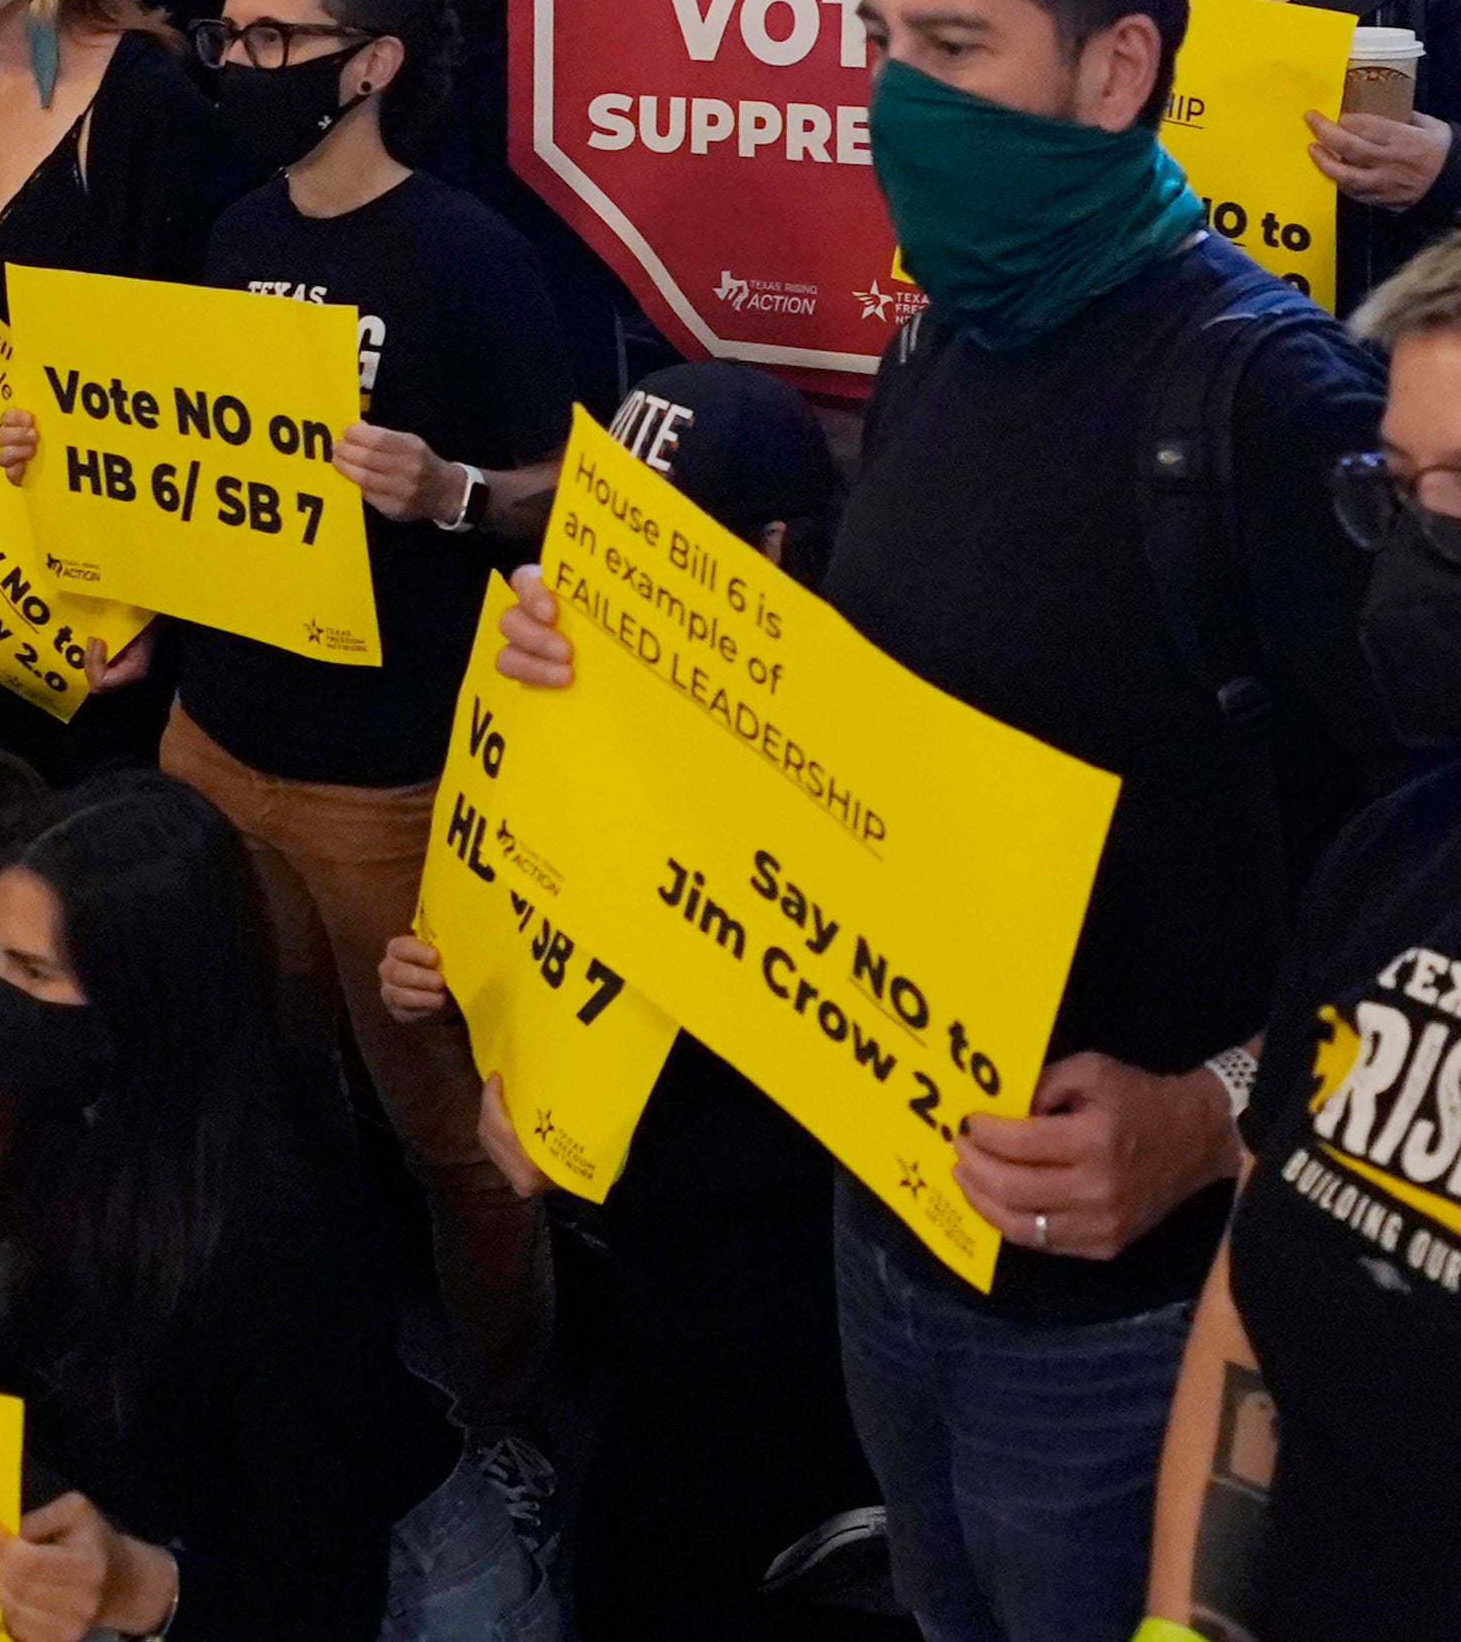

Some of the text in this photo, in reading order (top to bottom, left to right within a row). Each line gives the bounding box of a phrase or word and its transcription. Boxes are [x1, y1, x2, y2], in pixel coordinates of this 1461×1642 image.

[587, 92, 873, 165] SUPPRE
[1261, 213, 1311, 251] to
[747, 294, 816, 315] ACTION
[749, 280, 817, 294] TEXAS RISING
[896, 292, 930, 304] TEXA
[44, 366, 159, 429] Vote
[174, 387, 251, 446] NO
[269, 414, 333, 463] on
[67, 446, 324, 546] HB 6/ SB 7
[576, 453, 782, 640] House Bill 6 is
[0, 567, 51, 627] NO
[53, 625, 86, 670] to
[564, 511, 783, 695] an example of
[14, 642, 68, 693] 2.0
[556, 561, 886, 842] FAILED LEADERSHIP
[514, 854, 561, 898] ACTION
[576, 957, 625, 1027] 7
[658, 857, 745, 962] Jim
[762, 946, 897, 1084] Crow
[908, 1070, 970, 1142] 2.
[751, 849, 1000, 1097] Say NO to
[1281, 1149, 1402, 1253] BUILDING
